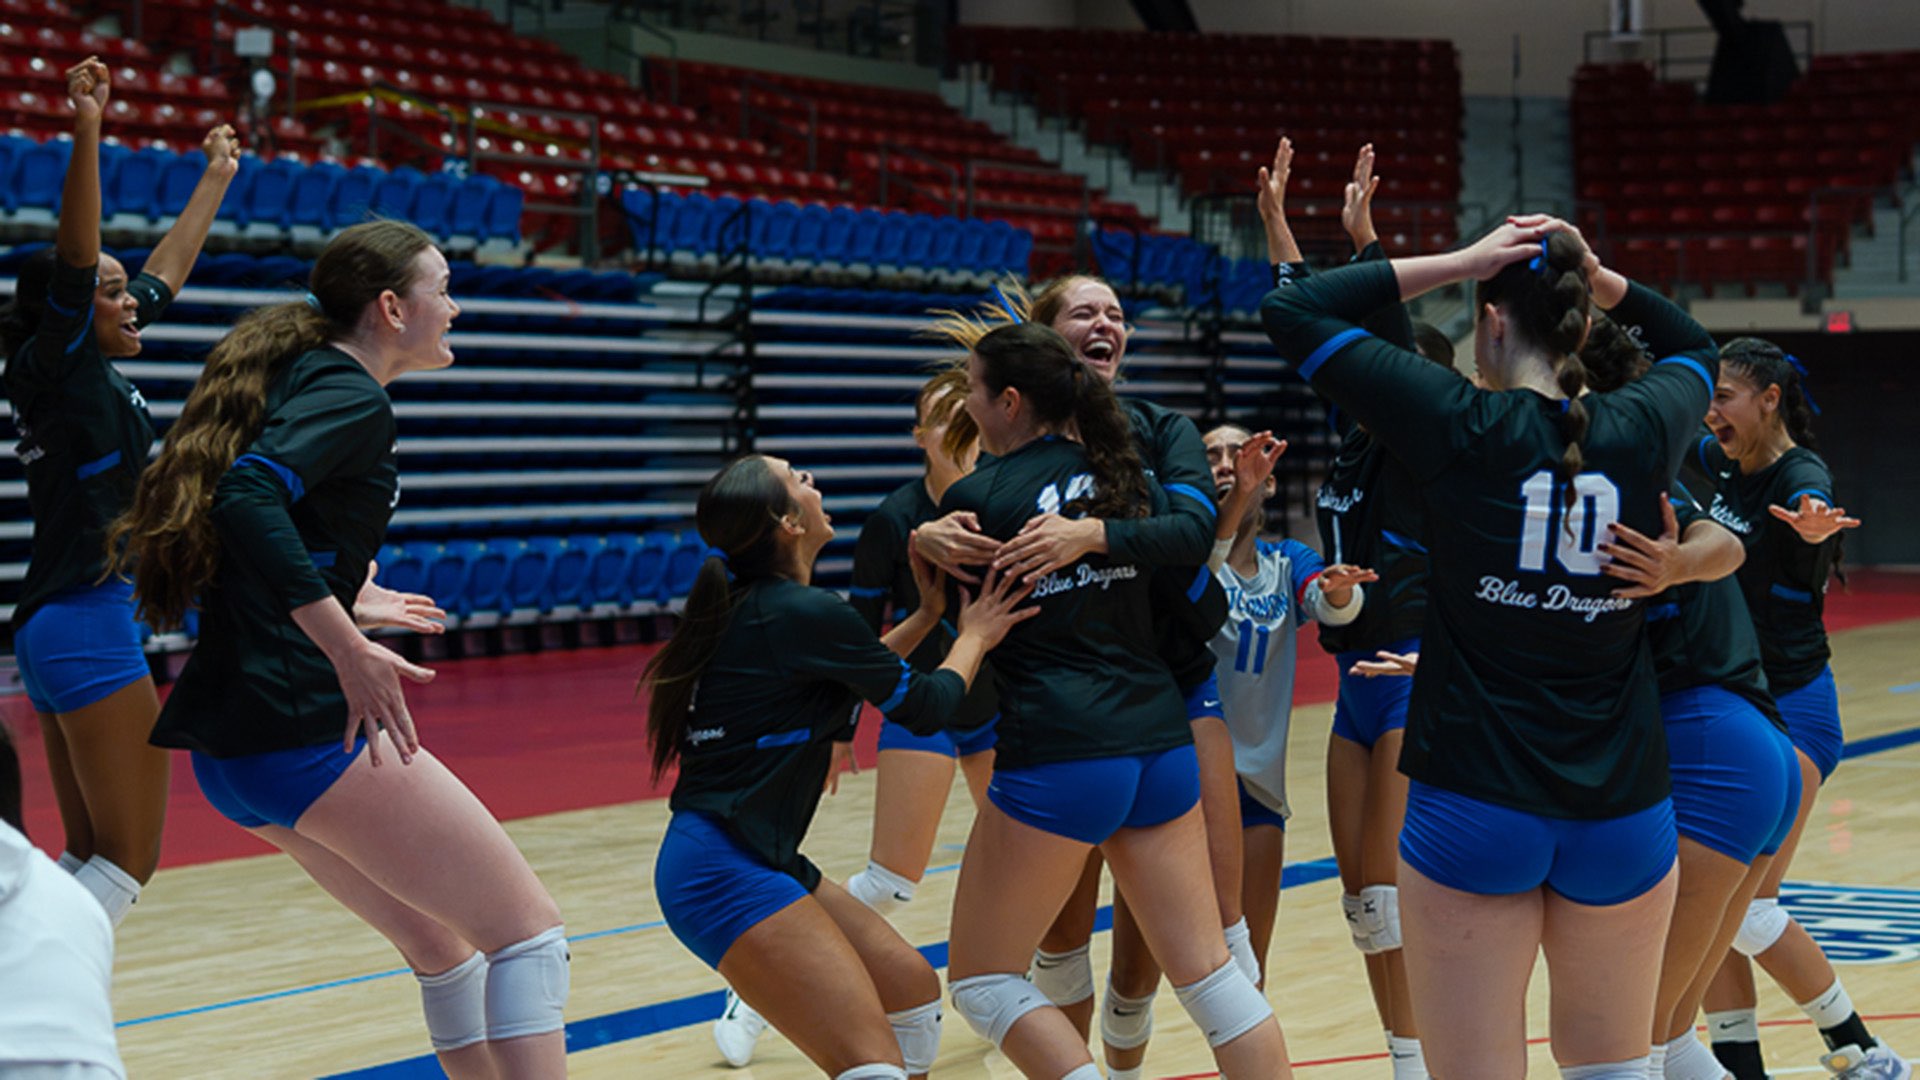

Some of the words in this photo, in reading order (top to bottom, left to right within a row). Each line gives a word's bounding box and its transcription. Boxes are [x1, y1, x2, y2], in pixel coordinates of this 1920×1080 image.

[1518, 470, 1620, 576] 10
[1030, 571, 1075, 599] Blue
[1075, 562, 1139, 590] Dragons
[1475, 575, 1538, 608] Blue
[1541, 584, 1633, 622] Dragons
[1234, 618, 1271, 675] 11
